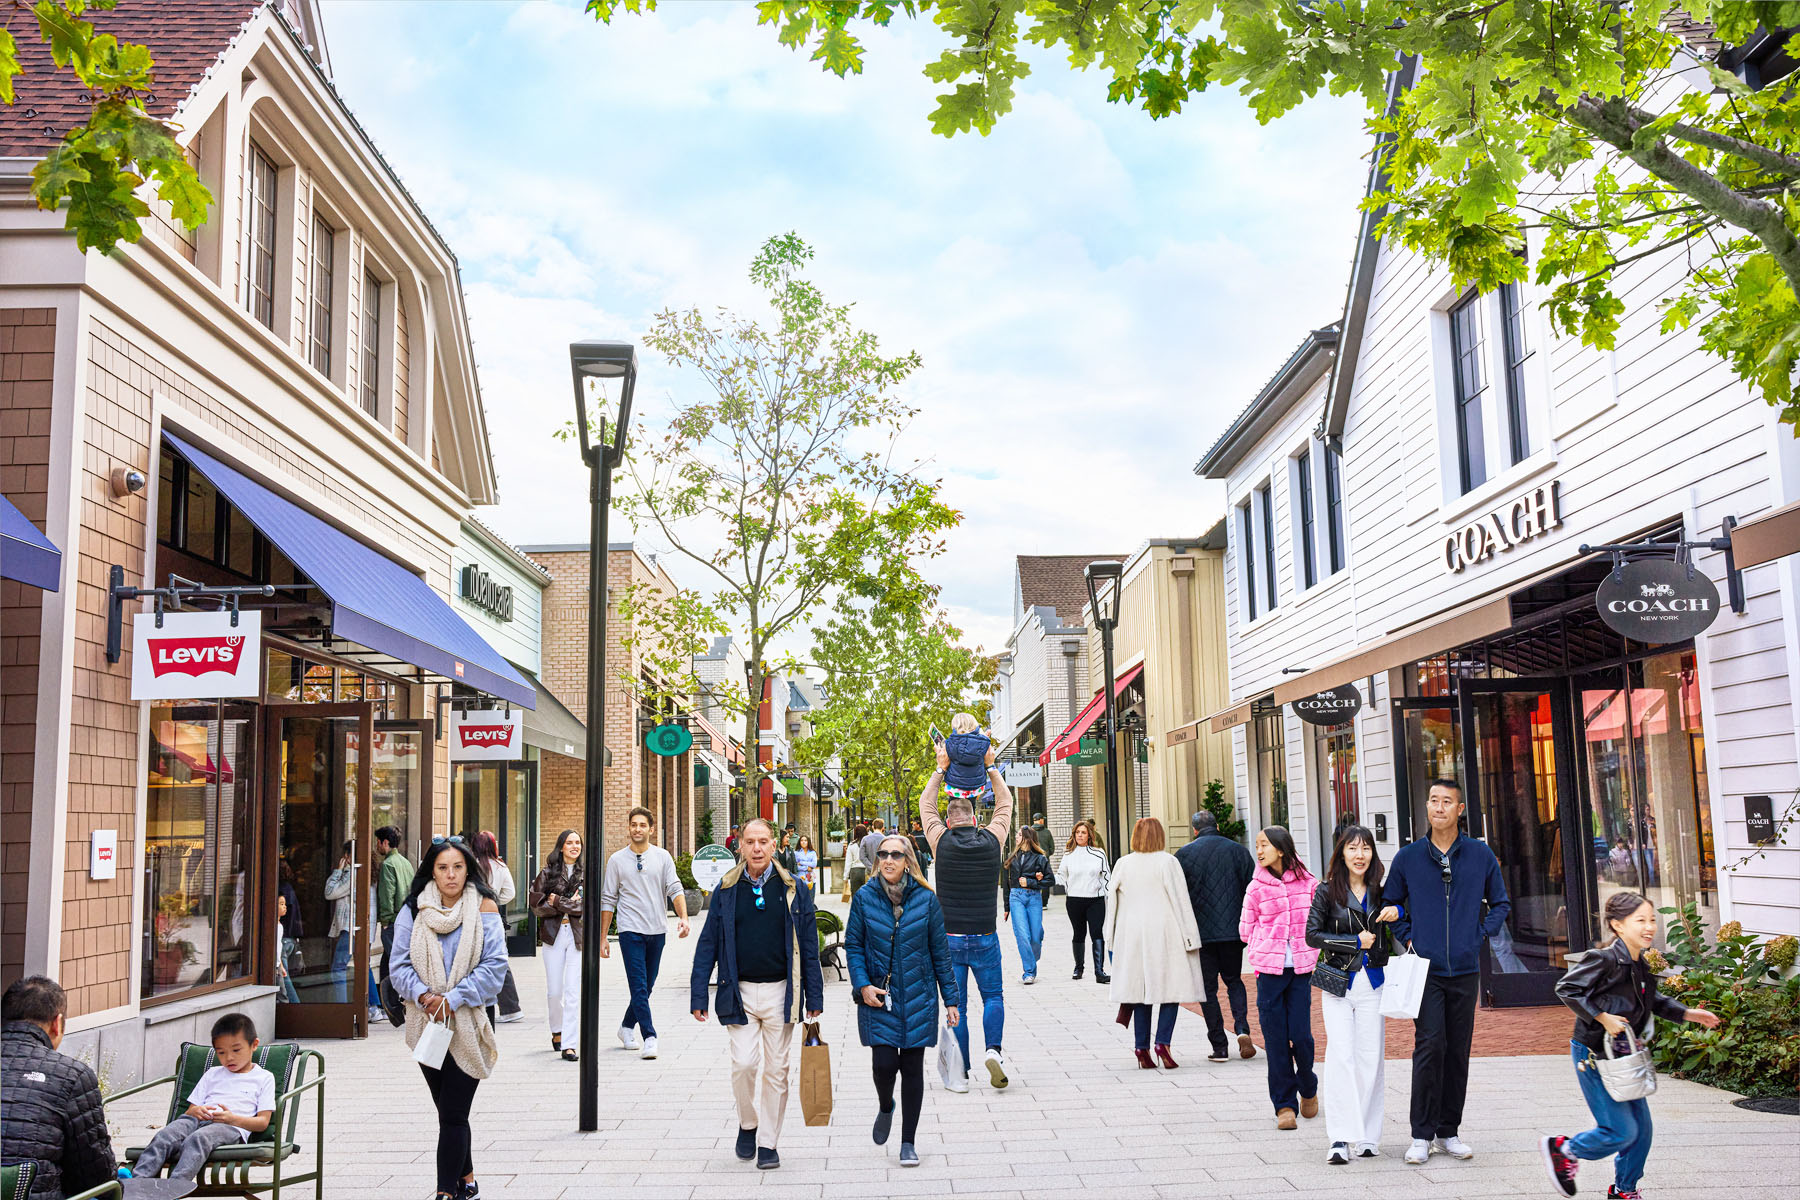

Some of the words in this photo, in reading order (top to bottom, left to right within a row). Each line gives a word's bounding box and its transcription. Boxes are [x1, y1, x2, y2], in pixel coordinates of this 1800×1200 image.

[1445, 480, 1561, 574] COACH
[1607, 598, 1711, 613] COACH
[1297, 699, 1357, 709] COACH
[1223, 714, 1238, 727] COACH
